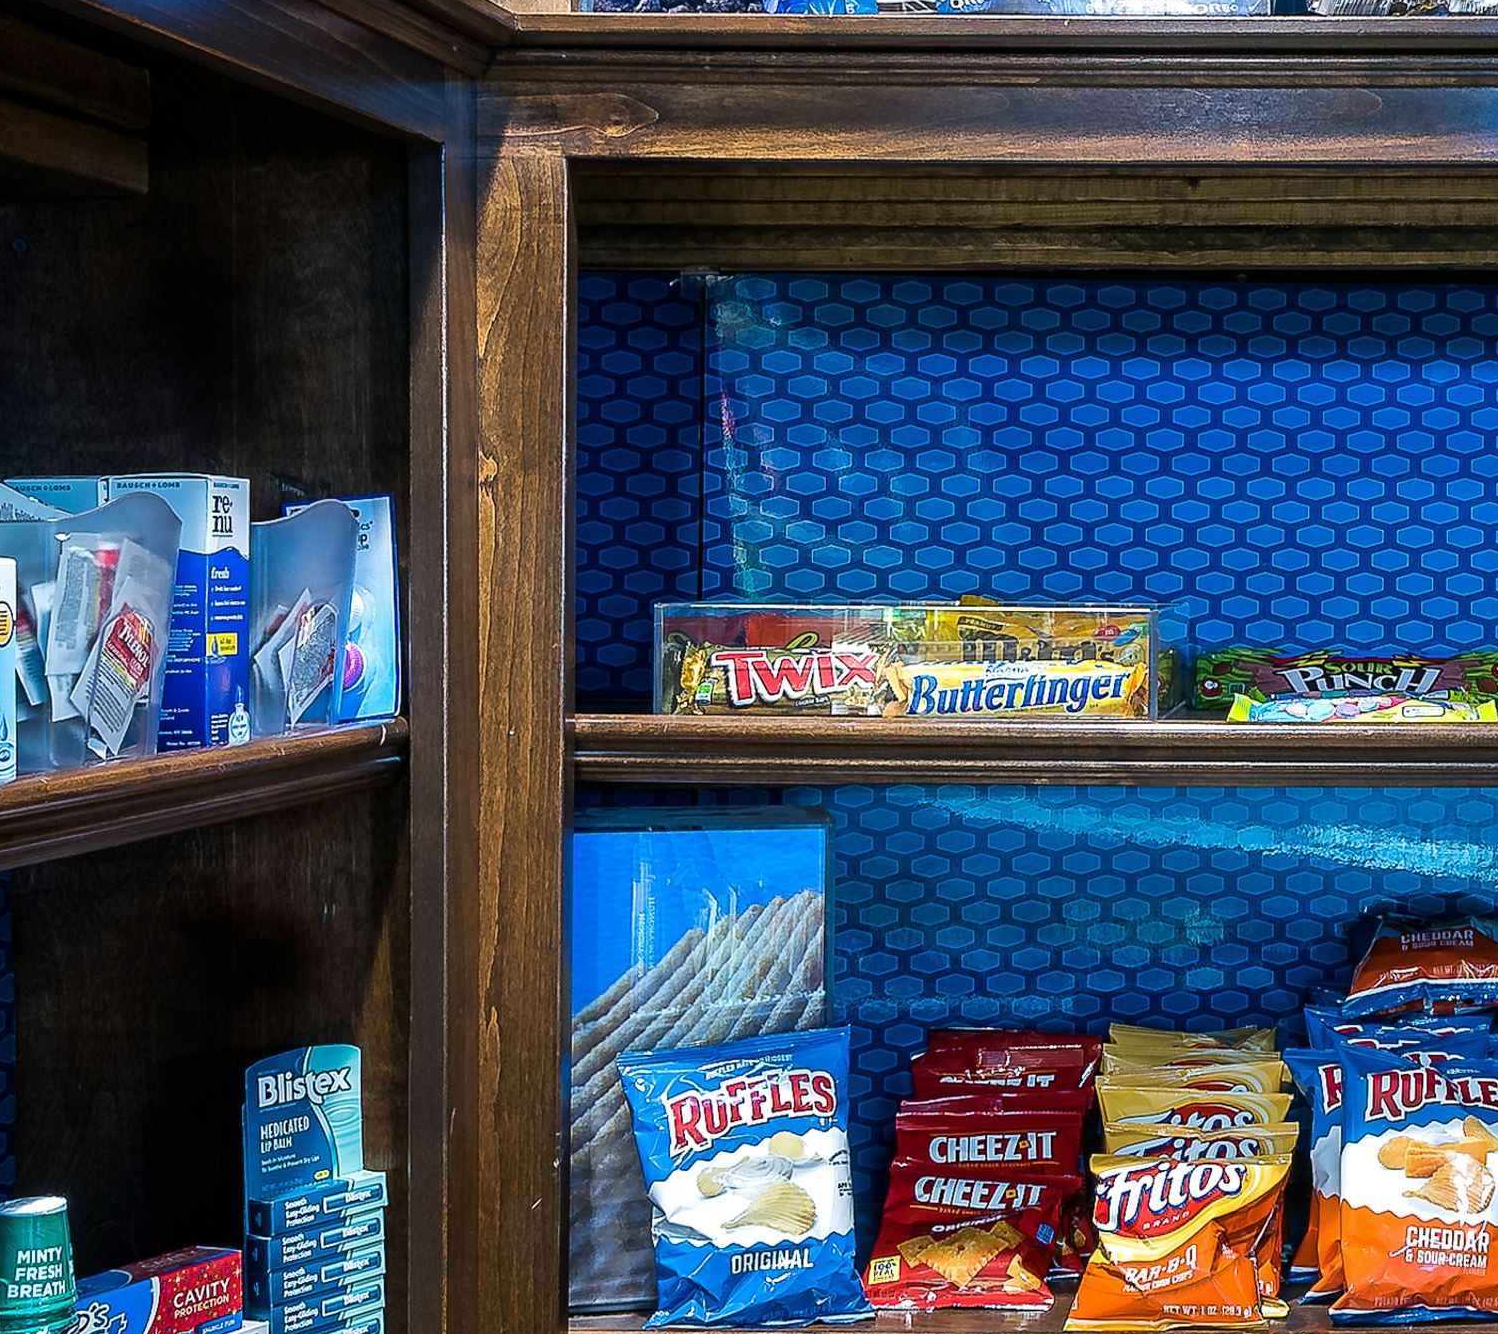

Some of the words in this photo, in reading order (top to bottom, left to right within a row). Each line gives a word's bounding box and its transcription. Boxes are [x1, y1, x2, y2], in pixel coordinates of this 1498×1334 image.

[117, 482, 150, 490] BAUSCH
[213, 515, 233, 533] nu
[211, 566, 230, 579] fresh
[117, 620, 151, 666] TYLENOL
[1324, 660, 1394, 675] SOUR
[713, 651, 876, 704] TWIX
[1275, 667, 1443, 693] PUNCH
[906, 673, 1130, 715] Butterfinger
[1402, 930, 1474, 944] CHEDDAR
[1413, 941, 1437, 949] SOUR
[1440, 939, 1474, 947] CREAM
[257, 1067, 351, 1108] Blistex
[670, 1072, 836, 1154] RUFFLES
[260, 1116, 310, 1140] MEDICATED
[261, 1140, 271, 1153] LIP
[274, 1137, 293, 1149] BALM
[1096, 1159, 1246, 1233] Fritos
[286, 1214, 315, 1227] Protection
[1142, 1211, 1190, 1231] BRAND
[1406, 1226, 1490, 1253] CHEDDAR
[17, 1246, 62, 1264] MINTY
[731, 1248, 814, 1274] ORIGINAL
[1406, 1249, 1414, 1262] &
[1417, 1250, 1446, 1265] SOUR
[1448, 1253, 1487, 1269] CREAM
[15, 1263, 63, 1281] FRESH
[1173, 1273, 1193, 1286] CHIPS
[7, 1280, 66, 1298] BREATH
[173, 1277, 231, 1308] CAVITY
[174, 1295, 230, 1319] PROTECTION
[1164, 1305, 1181, 1315] NET
[1207, 1306, 1217, 1315] OZ
[202, 1322, 223, 1334] SPARKLE
[224, 1319, 236, 1327] FUN
